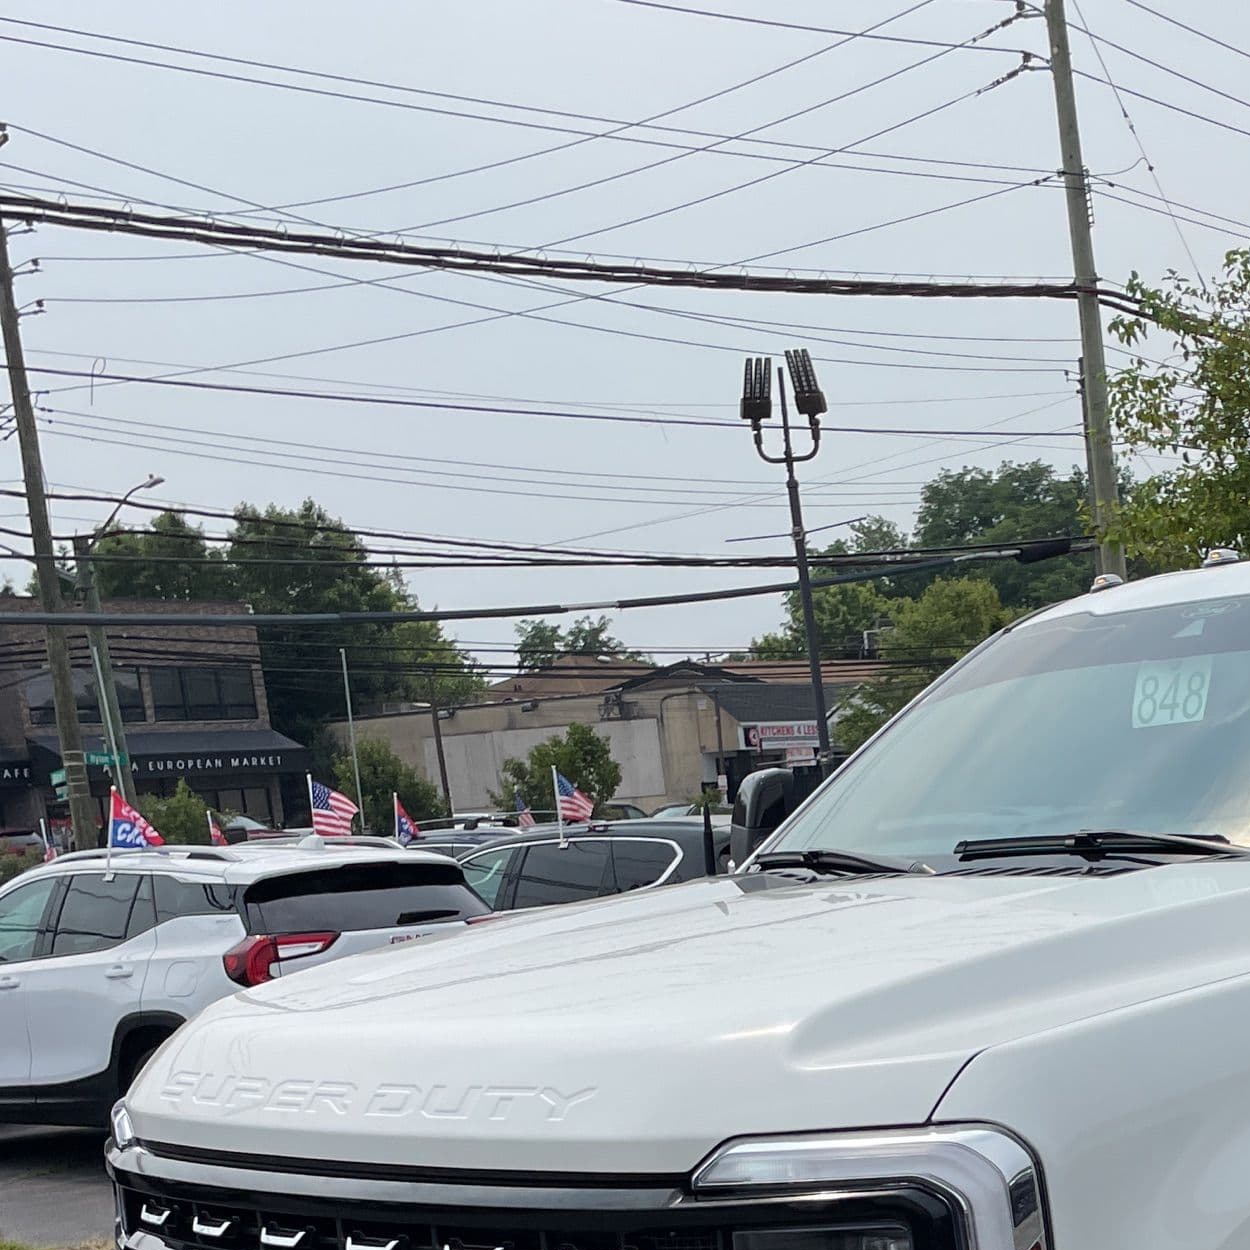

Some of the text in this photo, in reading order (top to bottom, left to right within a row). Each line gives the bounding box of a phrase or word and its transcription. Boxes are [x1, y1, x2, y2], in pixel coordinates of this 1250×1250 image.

[1137, 671, 1206, 724] 848
[149, 759, 222, 771] EUROPEAN
[231, 756, 282, 767] MARKET
[160, 1071, 598, 1121] SUPER DUTY
